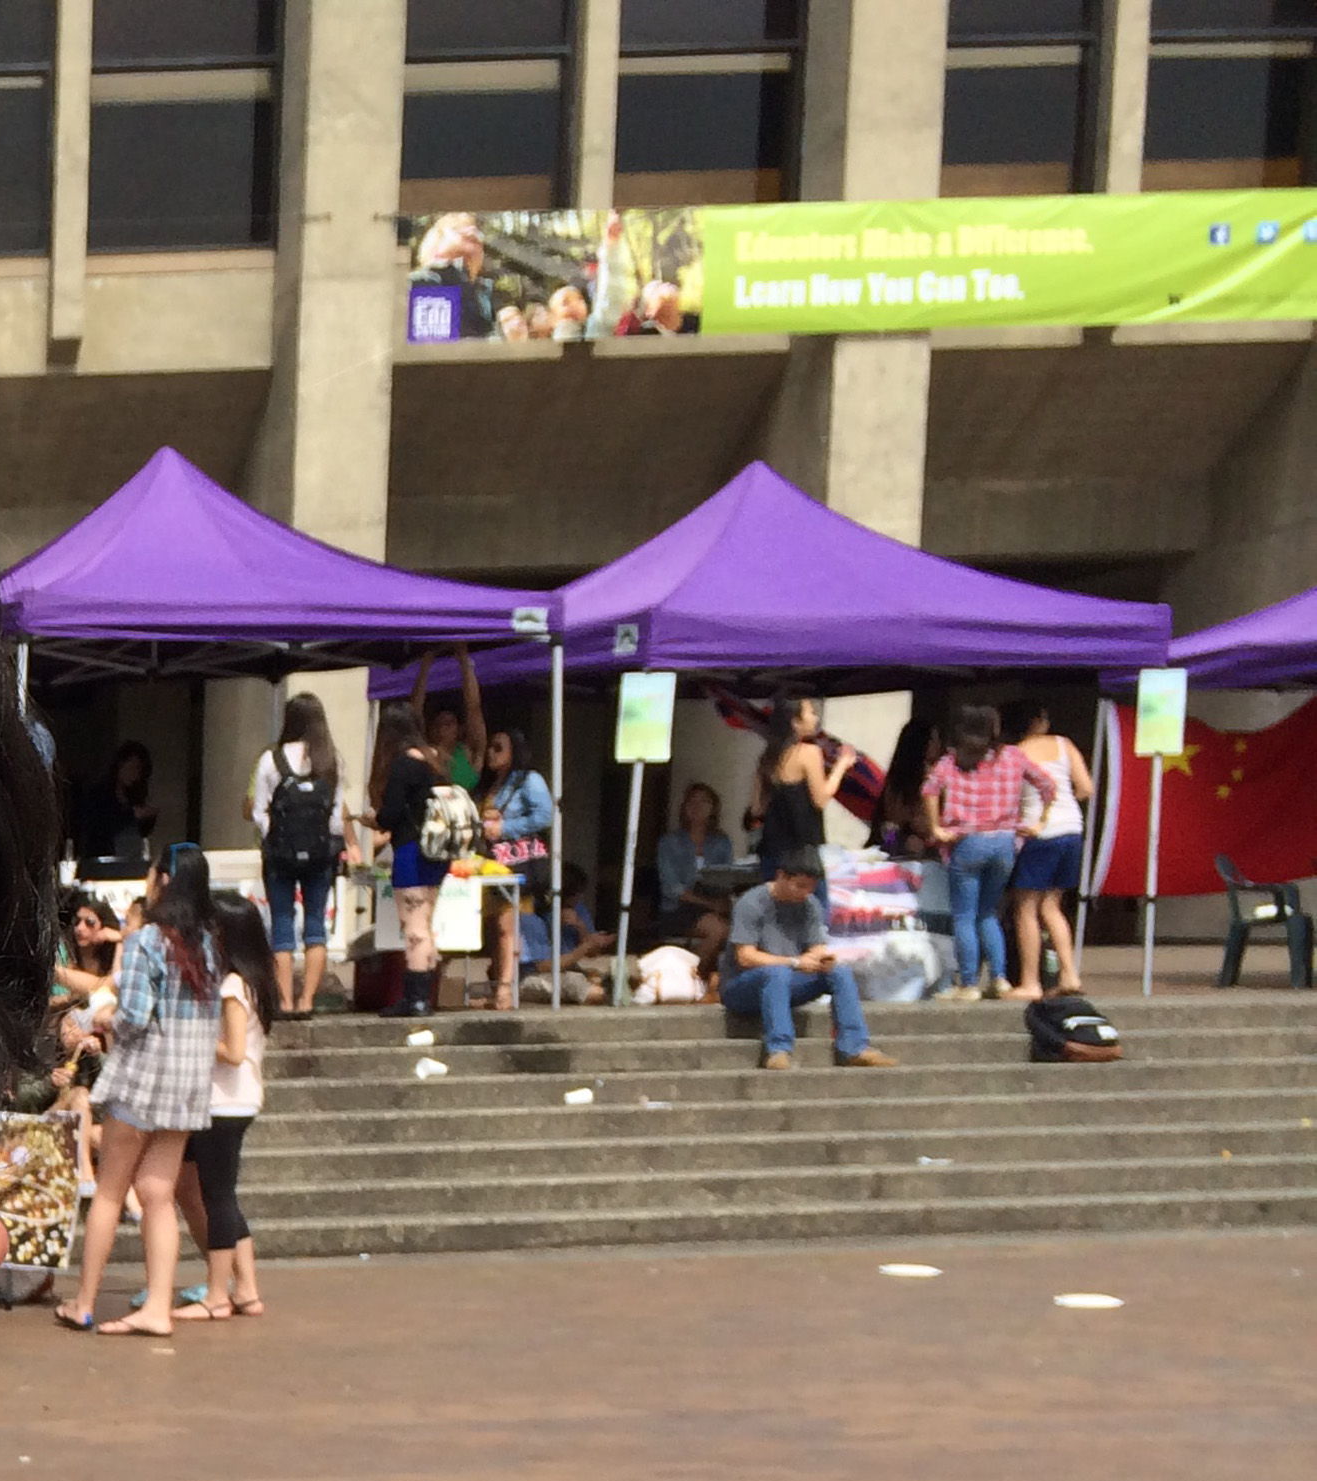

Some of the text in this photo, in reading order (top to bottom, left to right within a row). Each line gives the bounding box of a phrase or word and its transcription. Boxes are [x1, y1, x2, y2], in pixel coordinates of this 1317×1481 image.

[734, 268, 1026, 308] Learn How You Can Too.
